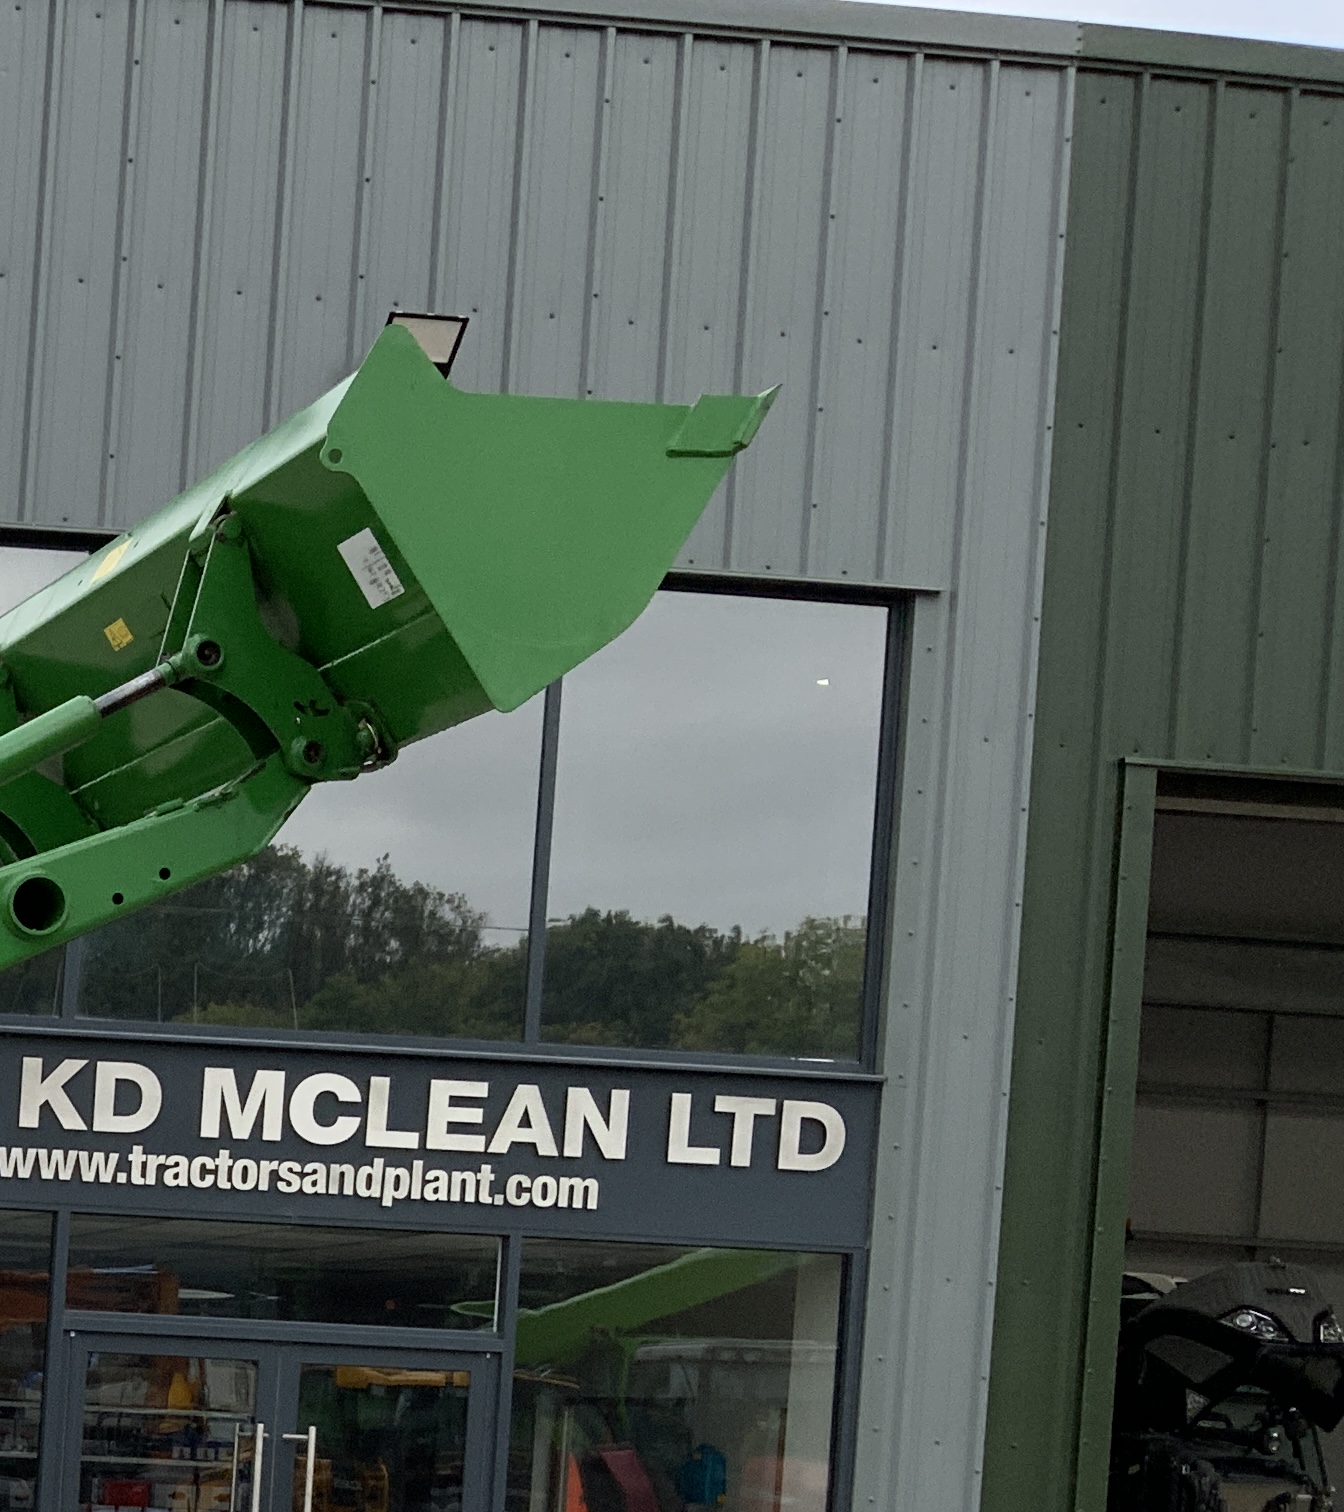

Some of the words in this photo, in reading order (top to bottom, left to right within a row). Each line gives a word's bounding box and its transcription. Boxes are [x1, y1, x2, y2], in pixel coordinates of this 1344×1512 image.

[18, 1055, 163, 1135] KD
[199, 1066, 631, 1161] MCLEAN
[667, 1092, 847, 1172] LTD
